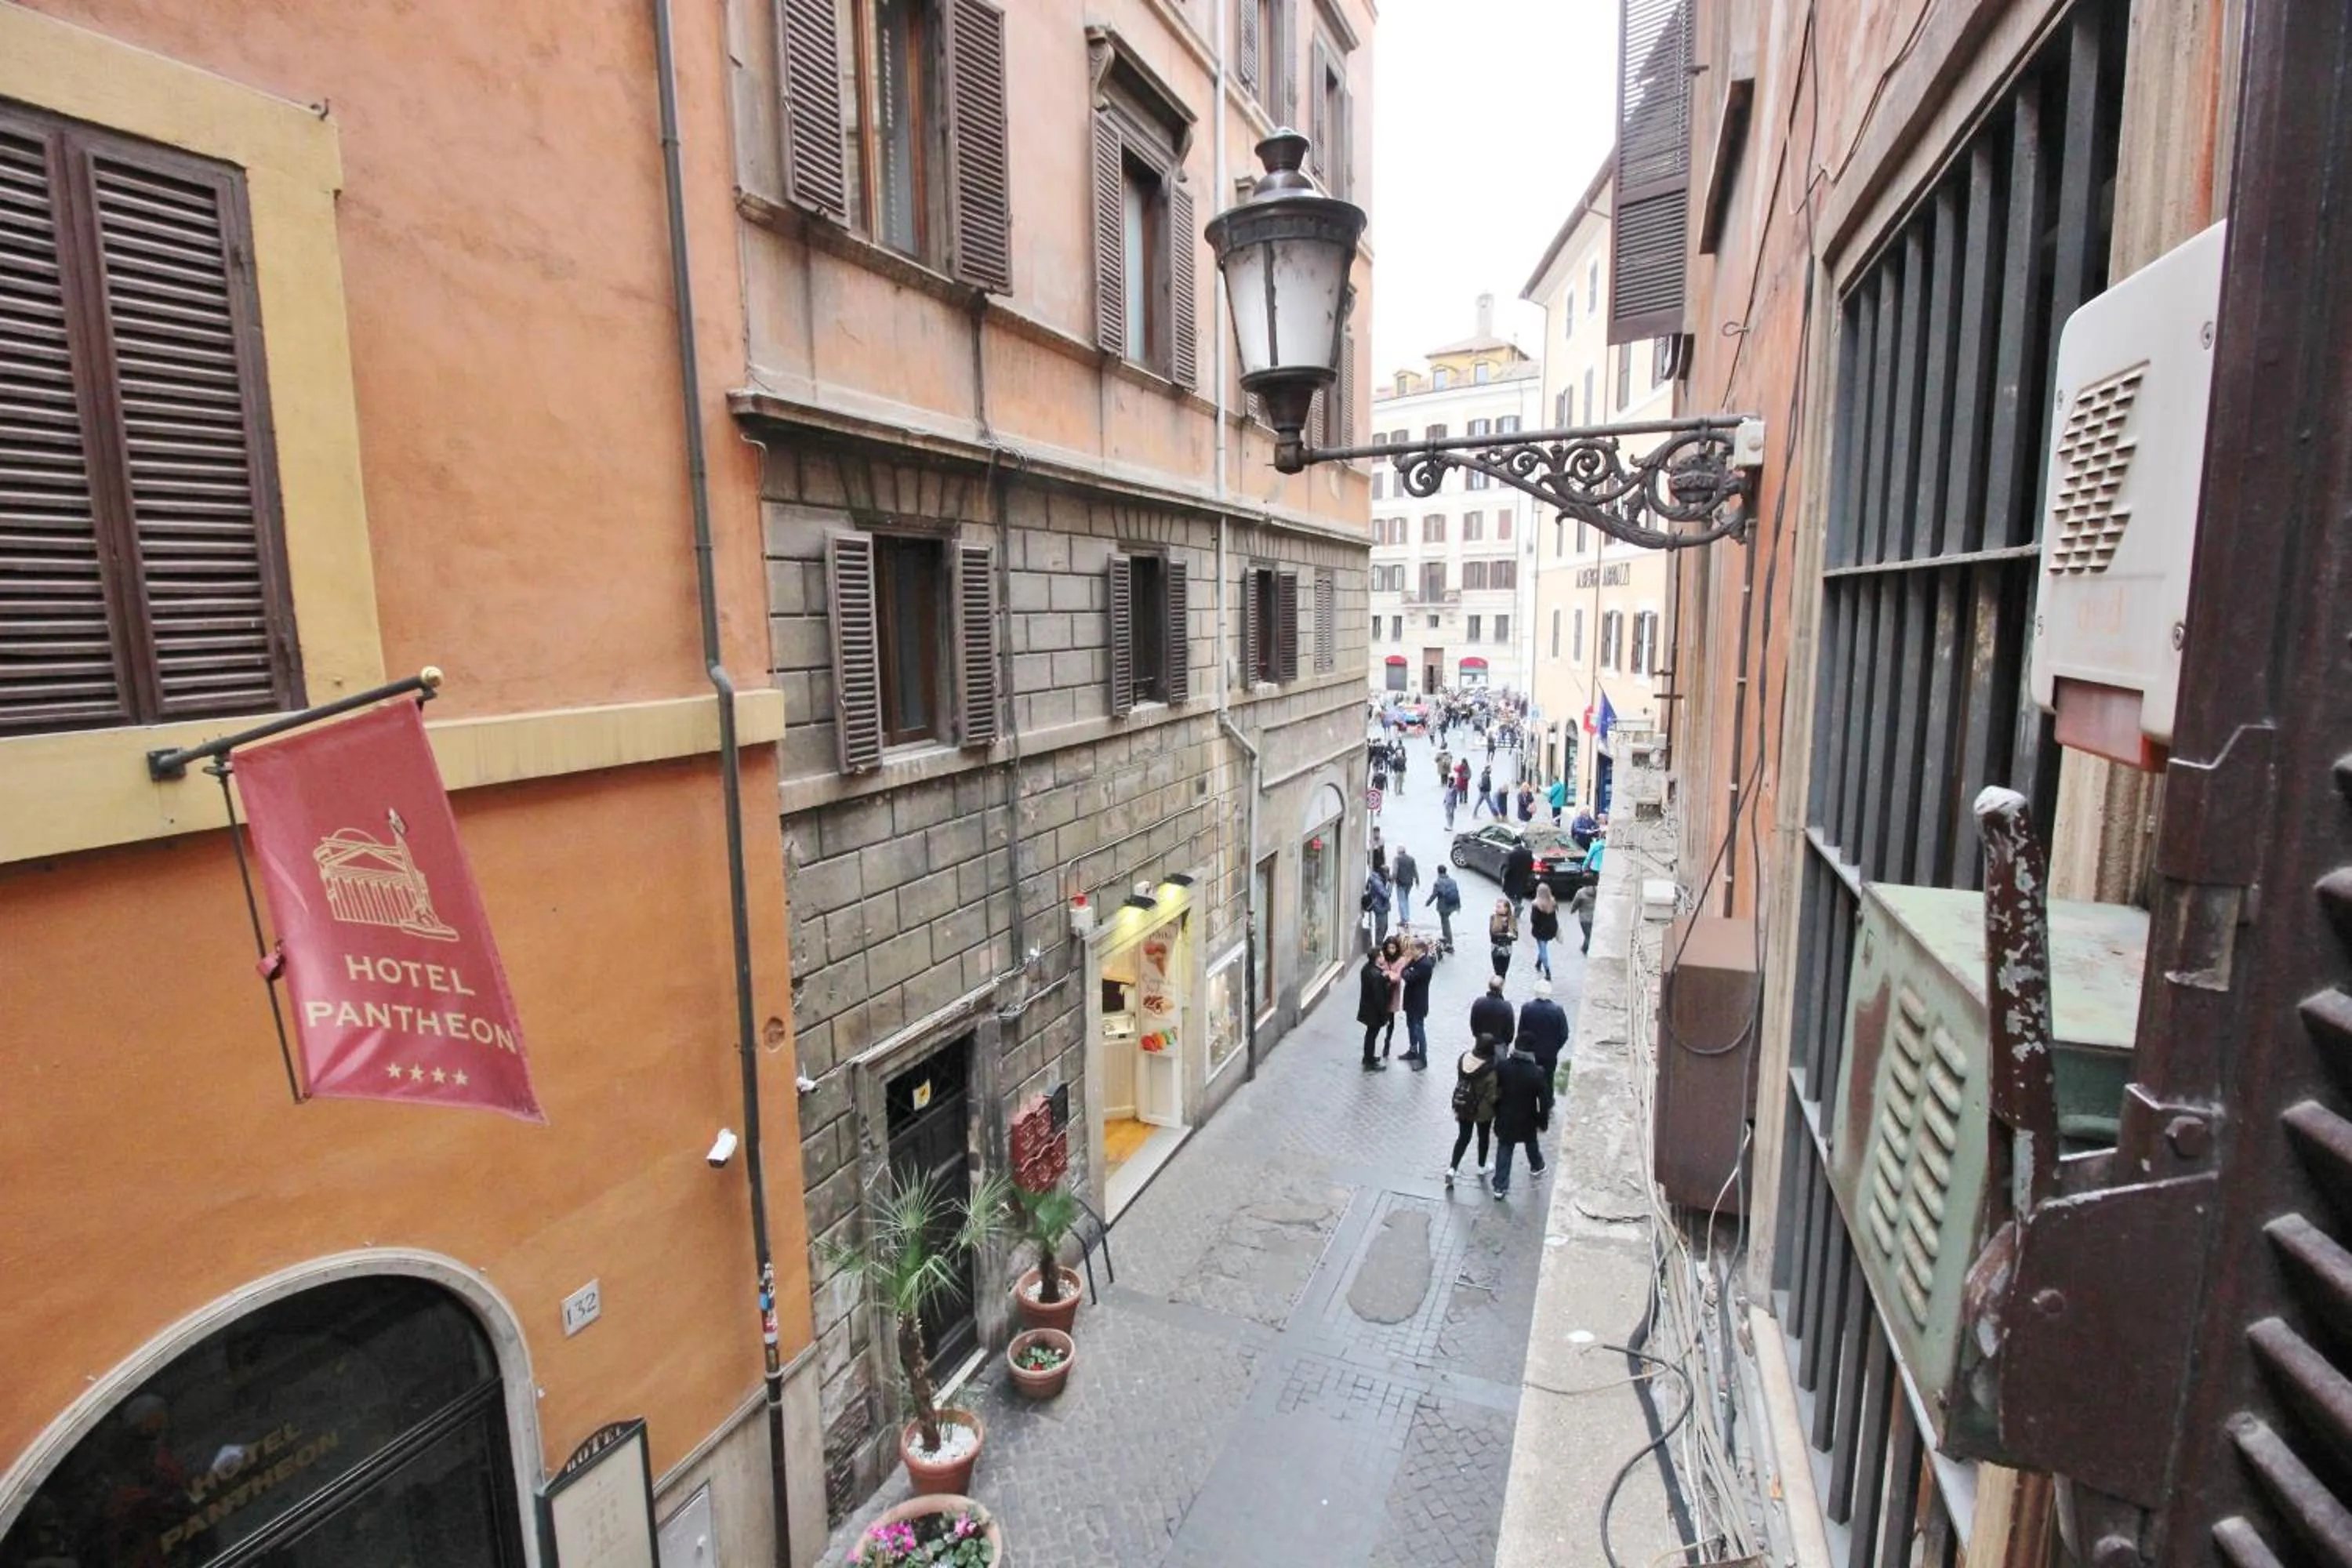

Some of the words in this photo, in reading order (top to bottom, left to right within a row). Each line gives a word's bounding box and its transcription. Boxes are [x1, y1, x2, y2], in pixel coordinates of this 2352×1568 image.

[345, 954, 475, 996] HOTEL
[304, 1000, 517, 1054] PANTHEON
[567, 1291, 597, 1327] 132
[188, 1421, 302, 1504] HOTEL
[160, 1430, 339, 1554] PANTHEON
